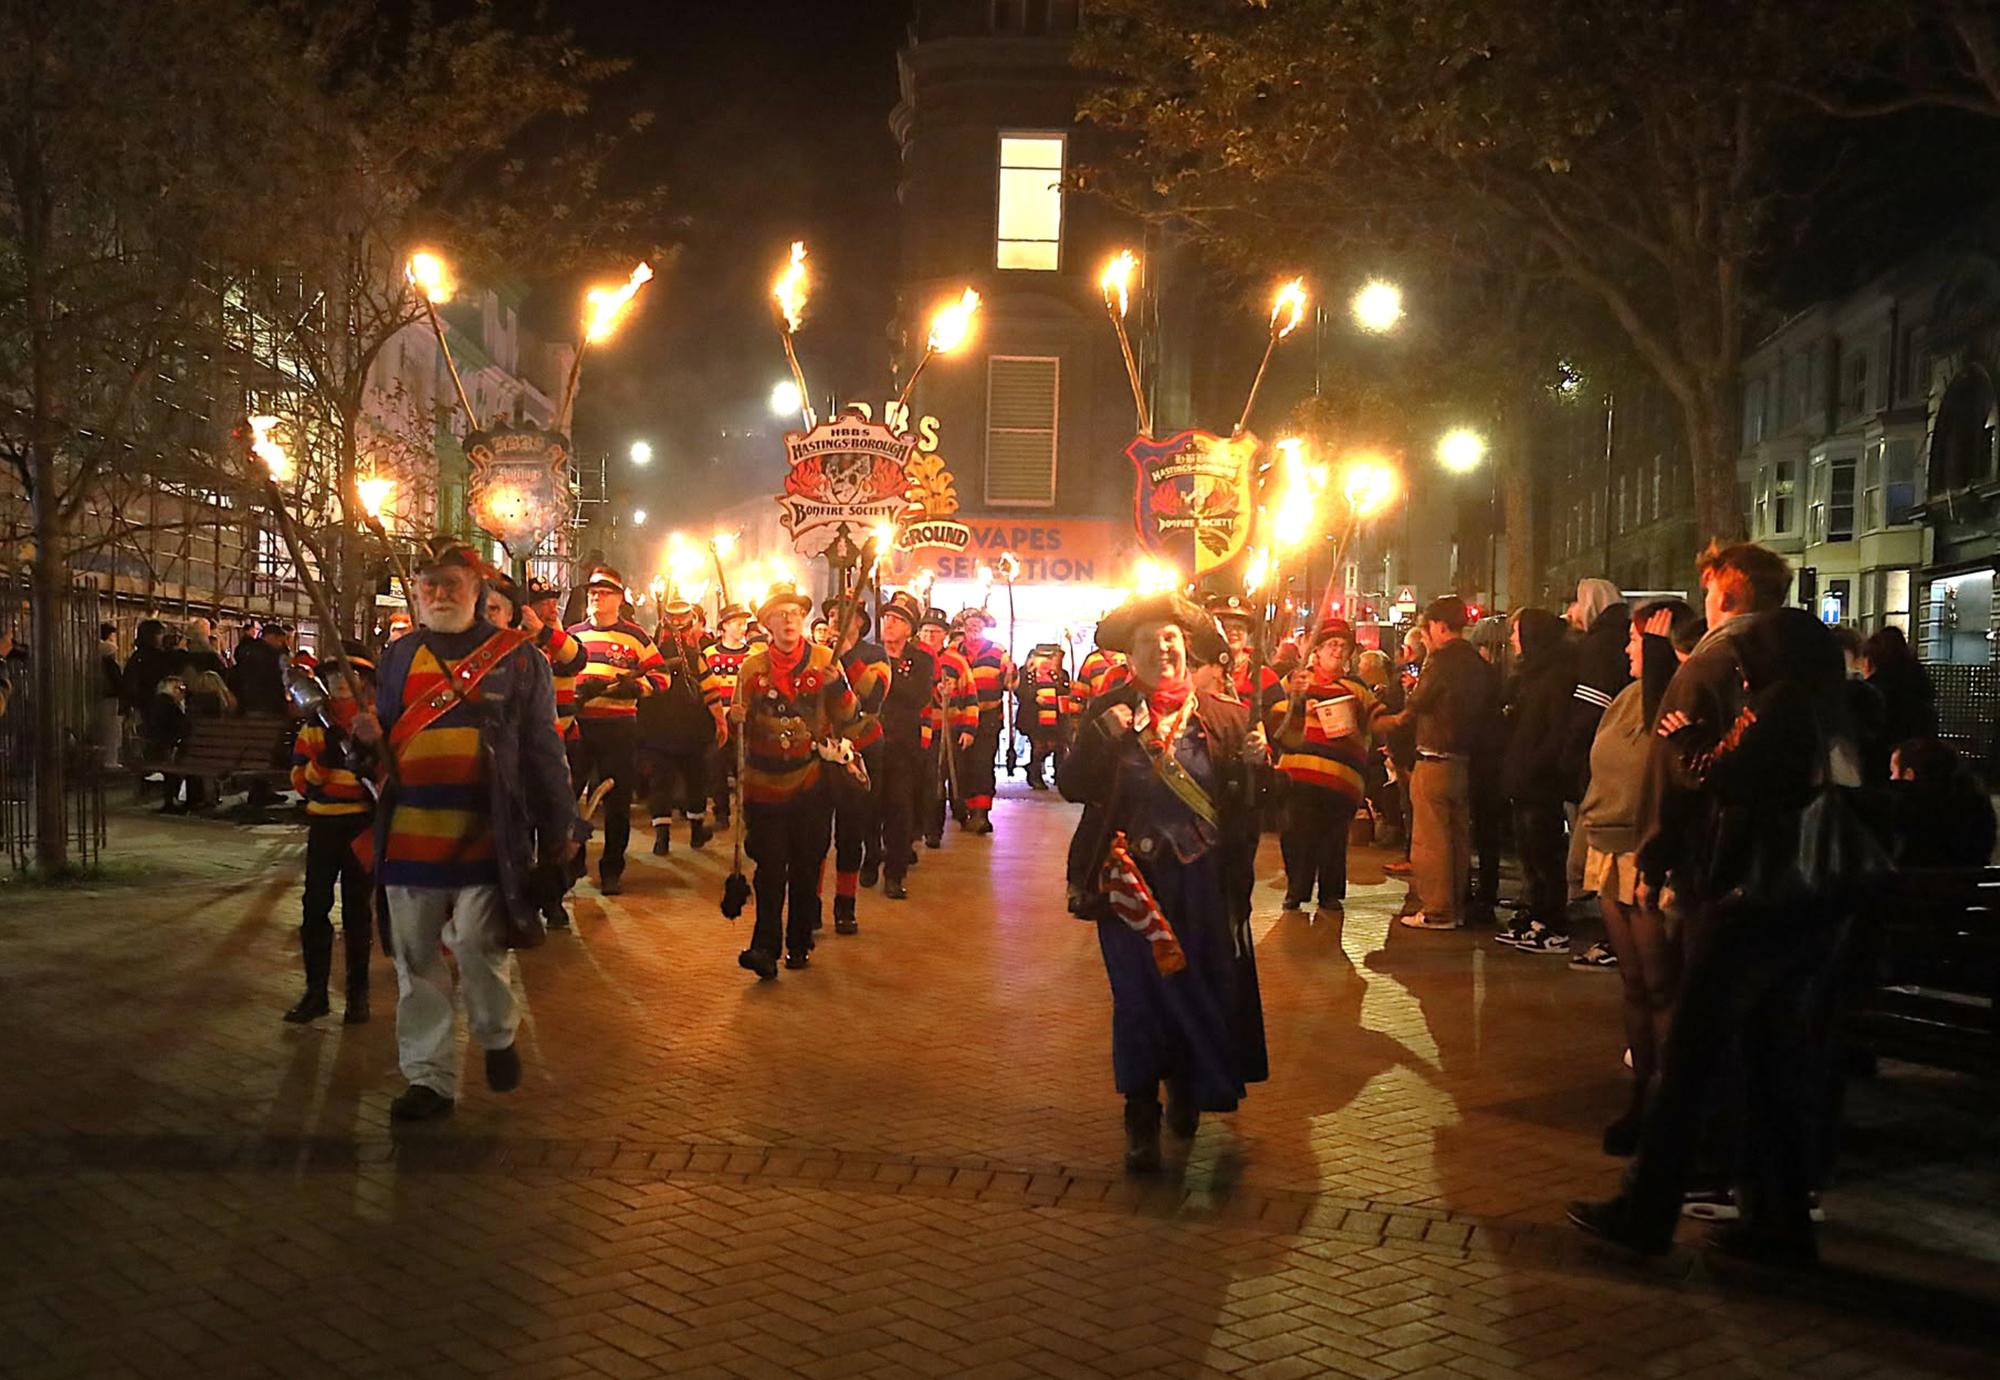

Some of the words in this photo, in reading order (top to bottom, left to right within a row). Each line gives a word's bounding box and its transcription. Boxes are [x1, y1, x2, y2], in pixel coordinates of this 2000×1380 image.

[831, 428, 870, 437] HBBS
[790, 501, 844, 527] BONFIRE
[849, 505, 898, 524] SOCIETY
[972, 527, 1062, 551] VAPES
